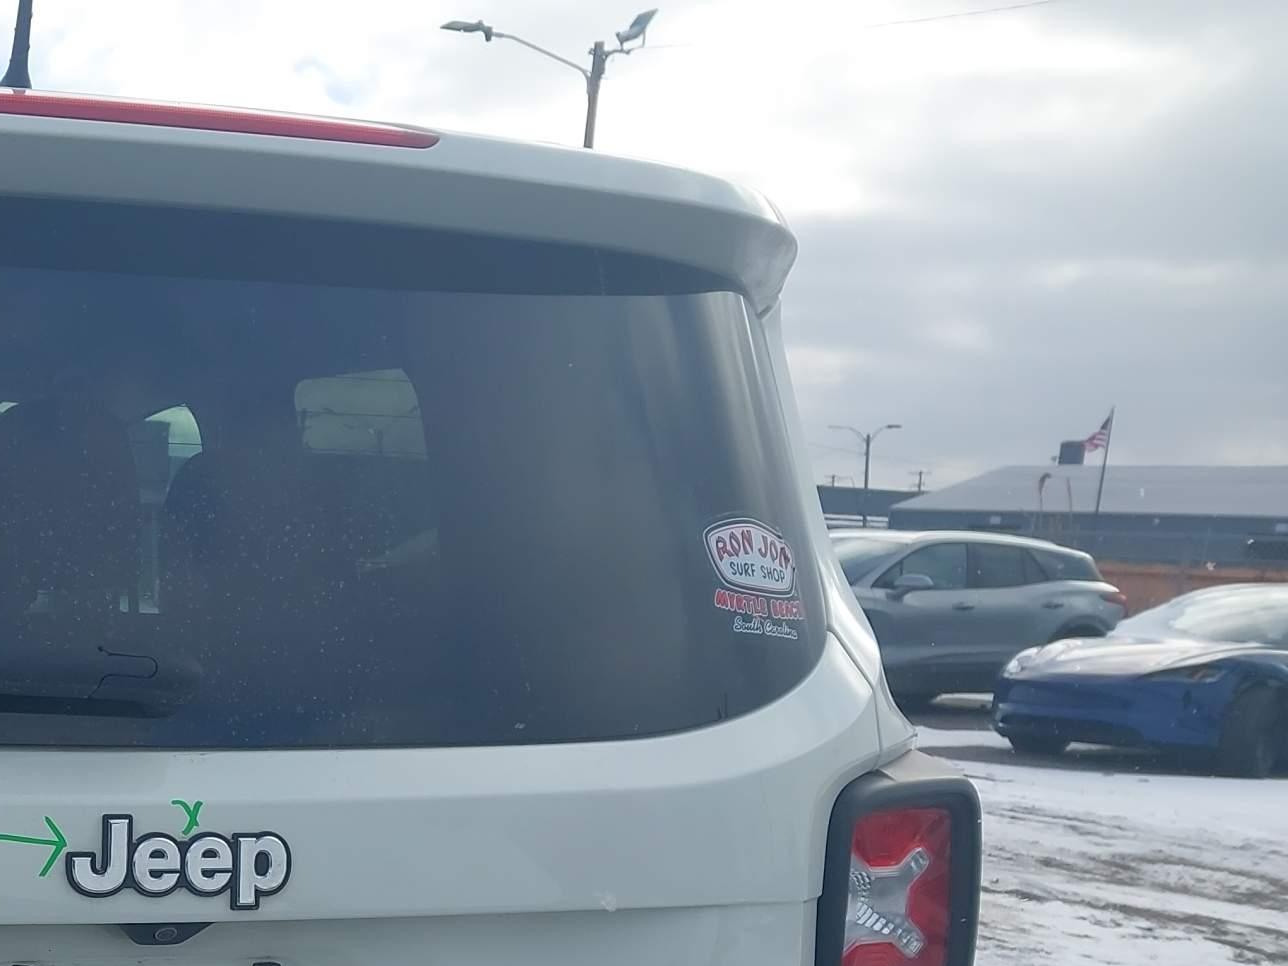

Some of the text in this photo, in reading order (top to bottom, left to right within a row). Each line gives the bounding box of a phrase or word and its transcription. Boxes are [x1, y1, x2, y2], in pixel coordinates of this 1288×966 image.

[715, 529, 790, 569] RON JON
[729, 561, 786, 583] SURF SHOP
[65, 813, 292, 911] Jeep
